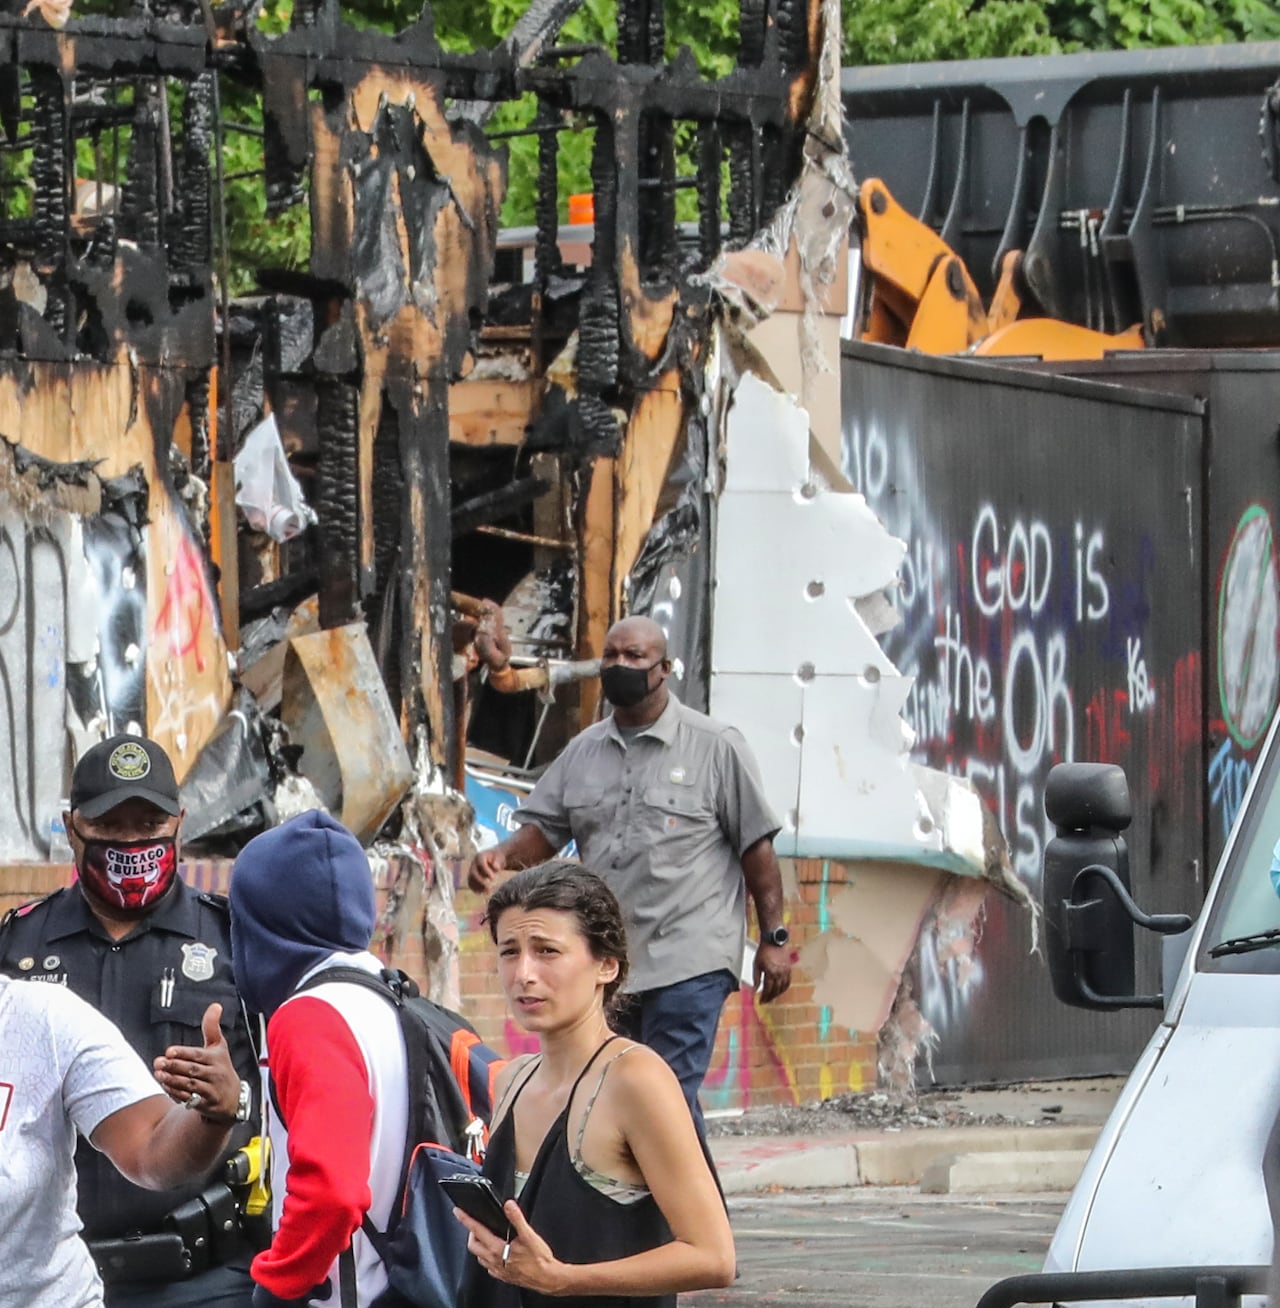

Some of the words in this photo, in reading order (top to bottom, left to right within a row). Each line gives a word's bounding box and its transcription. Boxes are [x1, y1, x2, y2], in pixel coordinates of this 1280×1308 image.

[970, 504, 1054, 618] GOD
[934, 604, 996, 724] the
[106, 848, 165, 866] CHICAGO
[112, 862, 155, 877] BULLS
